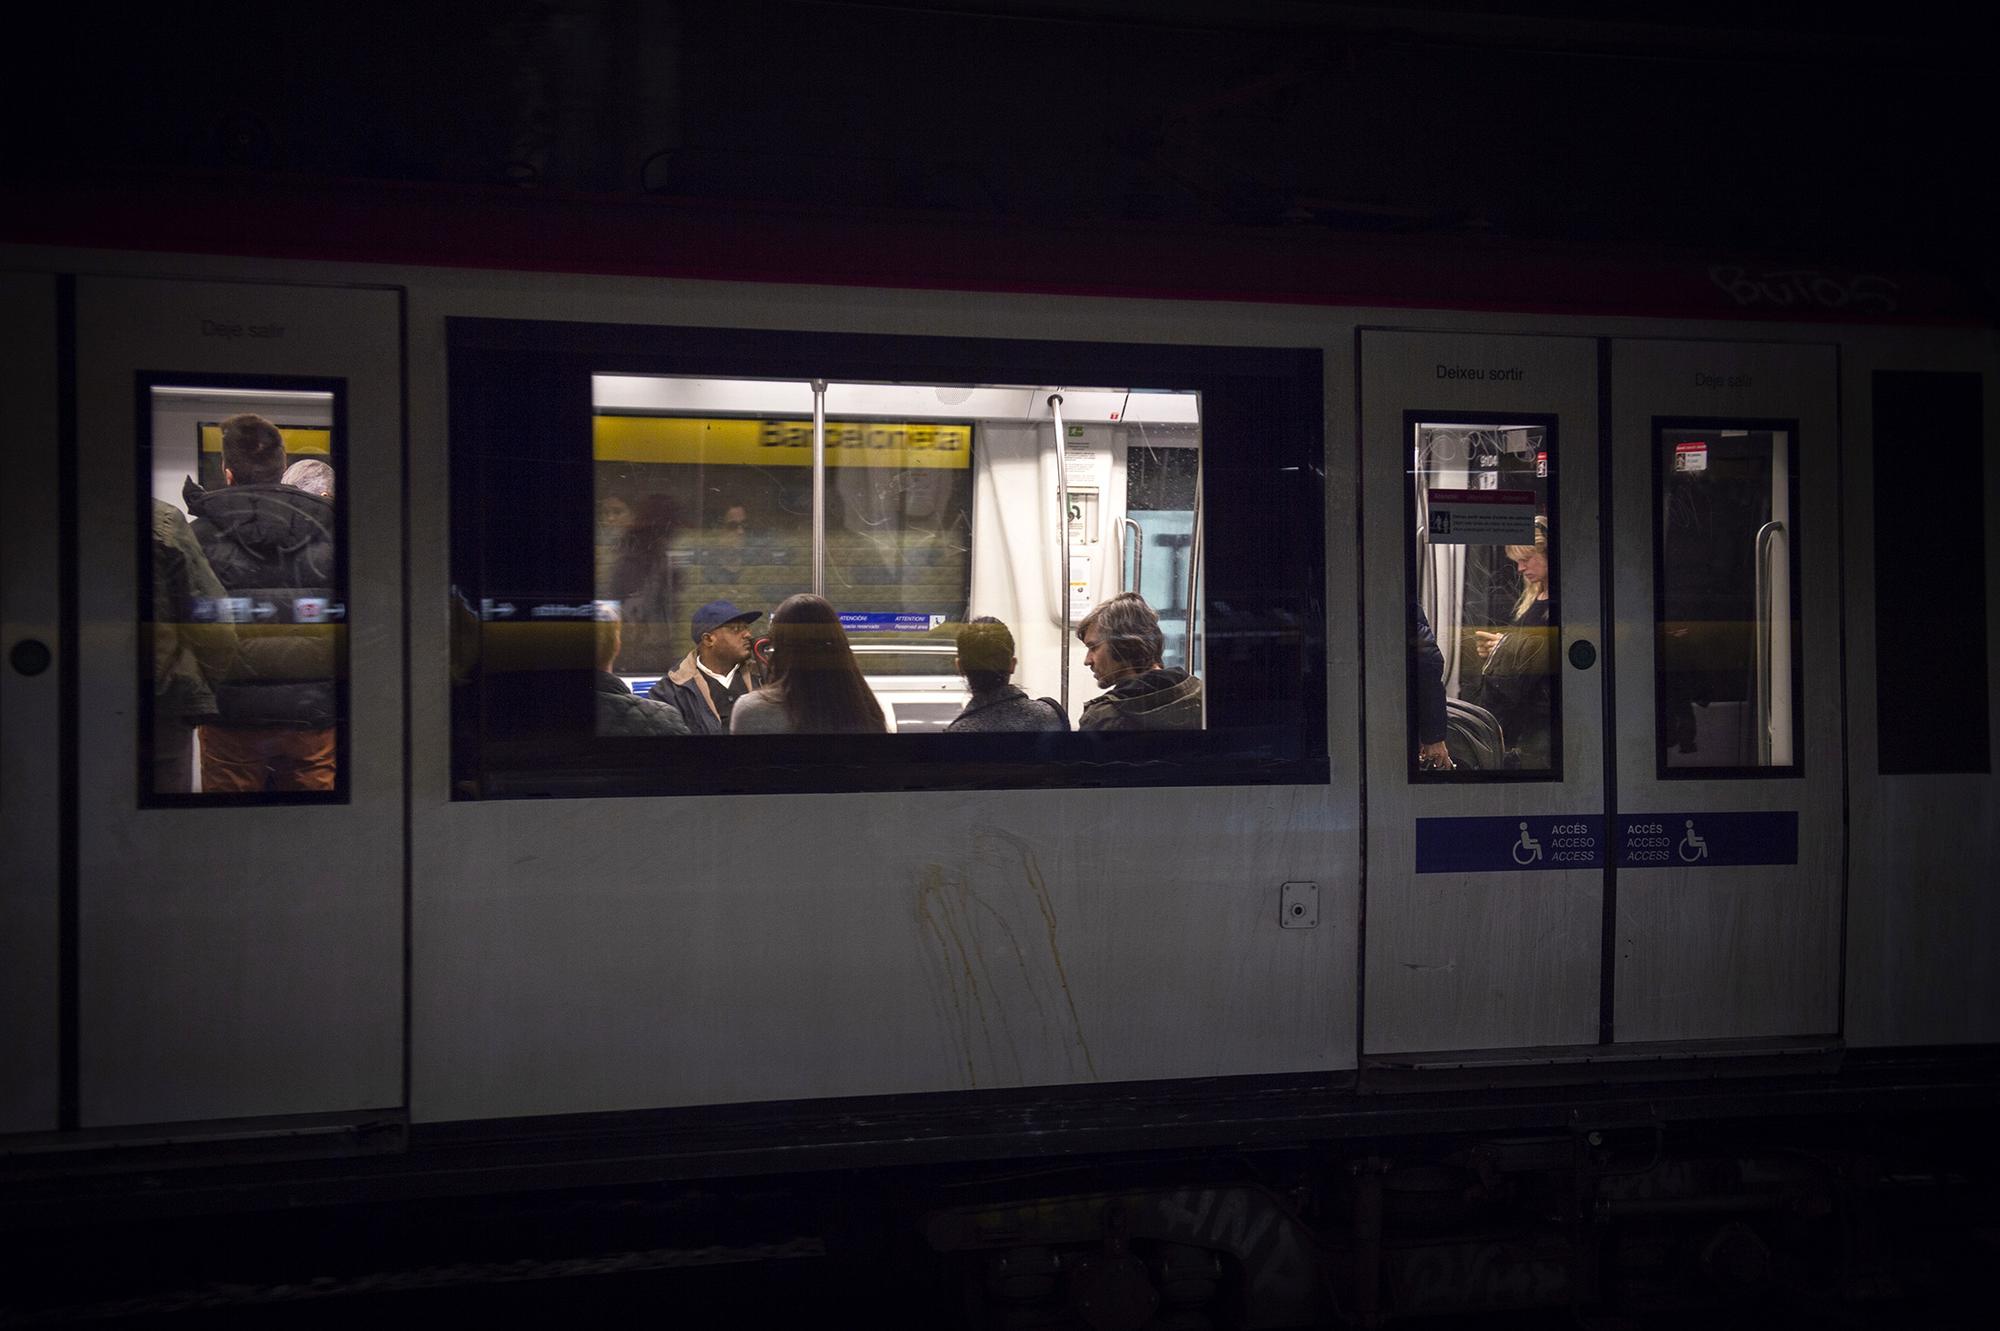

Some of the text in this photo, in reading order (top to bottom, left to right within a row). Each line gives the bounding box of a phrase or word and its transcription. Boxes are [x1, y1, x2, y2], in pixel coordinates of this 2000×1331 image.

[1436, 364, 1524, 381] Deixeu sortir
[1552, 823, 1588, 834] ACCÉS
[1552, 837, 1595, 848] ACCESO
[1627, 837, 1670, 848] ACCESO
[1552, 850, 1595, 861] ACCESS
[1627, 850, 1670, 861] ACCESS
